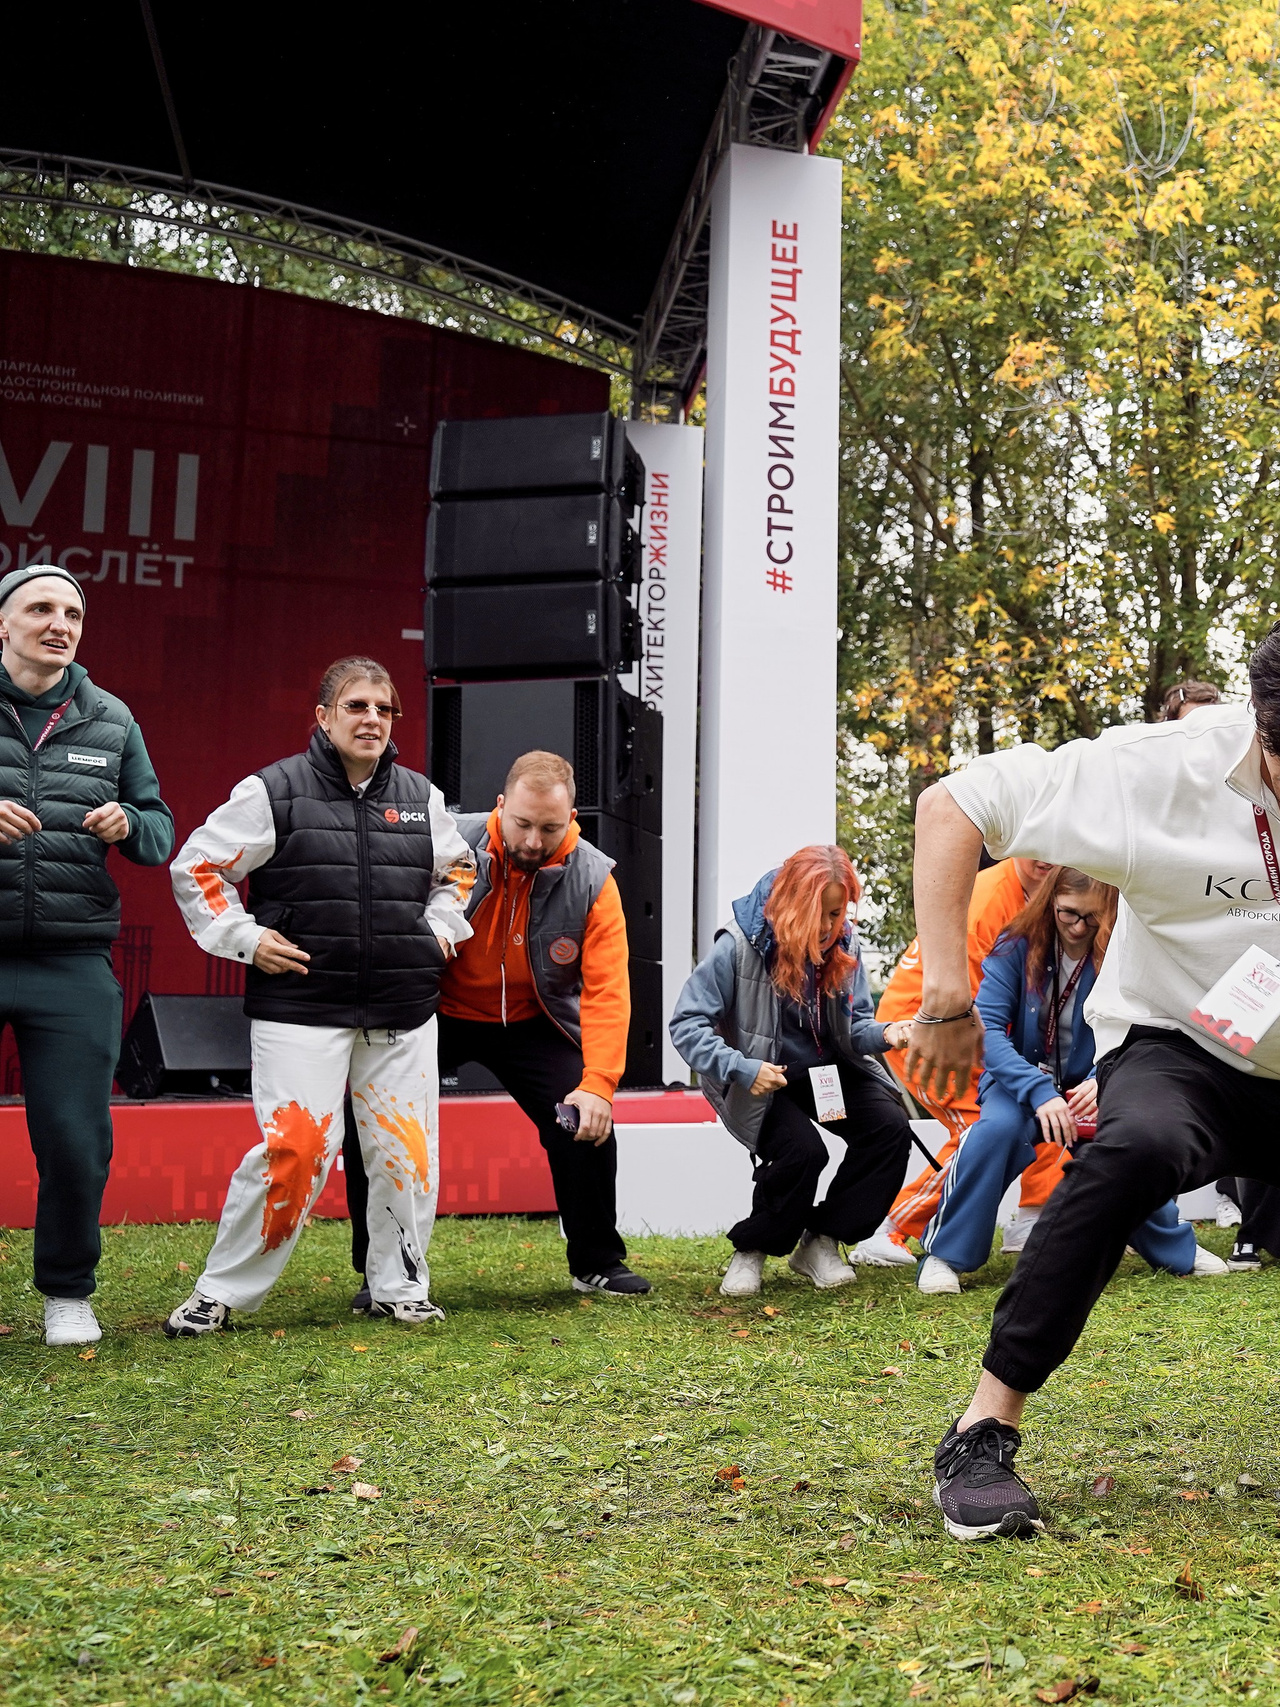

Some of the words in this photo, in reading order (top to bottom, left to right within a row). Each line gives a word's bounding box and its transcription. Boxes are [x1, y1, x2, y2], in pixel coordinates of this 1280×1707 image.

[40, 393, 102, 409] МОСКВЫ
[134, 389, 204, 406] ПОЛИТИКИ
[766, 219, 803, 594] #СТРОИМБУДУЩЕЕ
[400, 811, 427, 824] ФСК
[1260, 831, 1276, 865] ГОРОДА
